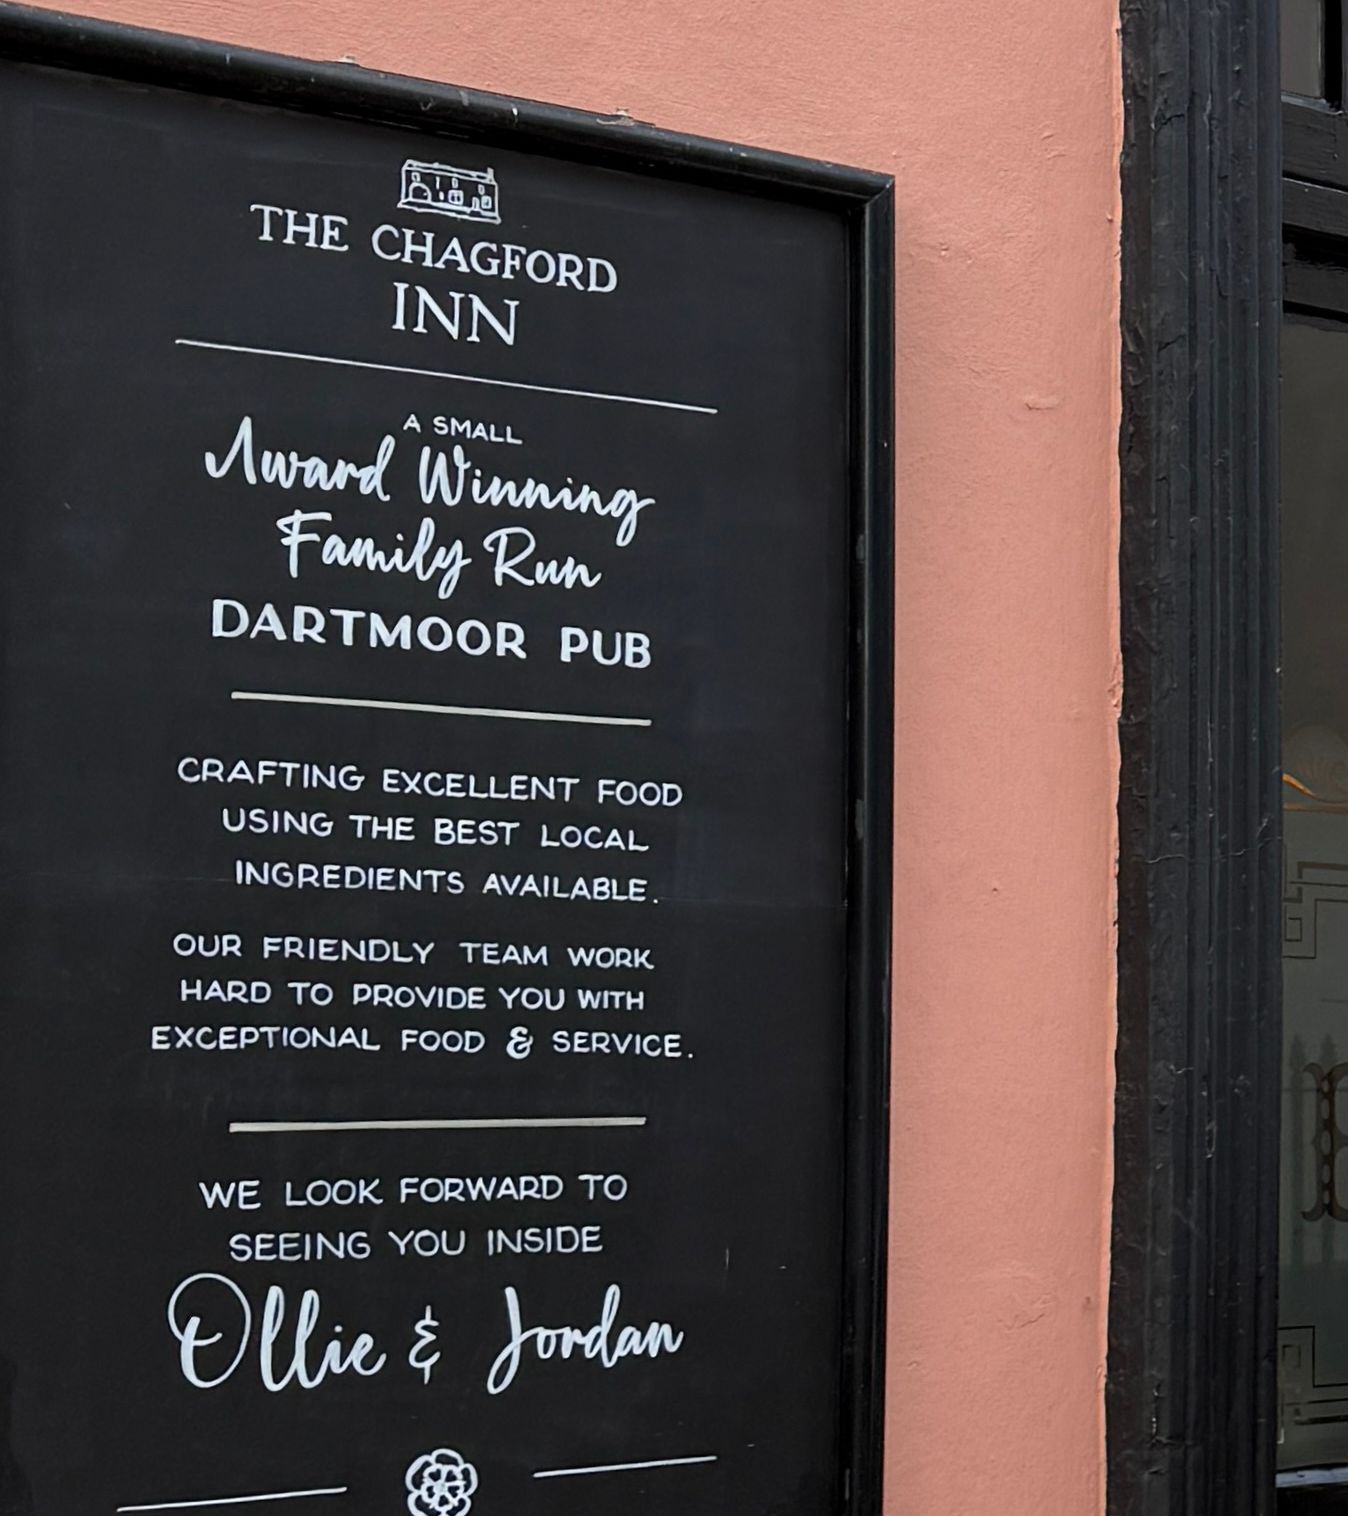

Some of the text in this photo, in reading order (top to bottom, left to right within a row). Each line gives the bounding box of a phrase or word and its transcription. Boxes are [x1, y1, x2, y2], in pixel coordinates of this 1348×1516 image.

[249, 203, 618, 294] THE CHAGFORD
[391, 281, 520, 346] INN
[402, 413, 523, 445] A SMALL
[204, 415, 656, 546] Award Winning
[275, 508, 602, 600] Family Run
[211, 596, 652, 669] DARTMOOR PUB
[177, 757, 683, 807] CRAFTING EXCELLENT FOOD
[222, 807, 650, 852] USING THE BEST LOCAL
[235, 859, 659, 904] INGREDIENTS AVAILABLE.
[173, 933, 655, 970] OUR FRIENDLY TEAM WORK
[180, 979, 645, 1011] HARD TO PROVIDE YOU WITH
[151, 1025, 694, 1060] EXCEPTIONAL FOOD & SERVICE.
[198, 1173, 628, 1210] WE LOOK FORWARD TO
[229, 1225, 603, 1262] SEEING YOU INSIDE
[167, 1272, 684, 1395] Ollie & Jordan
